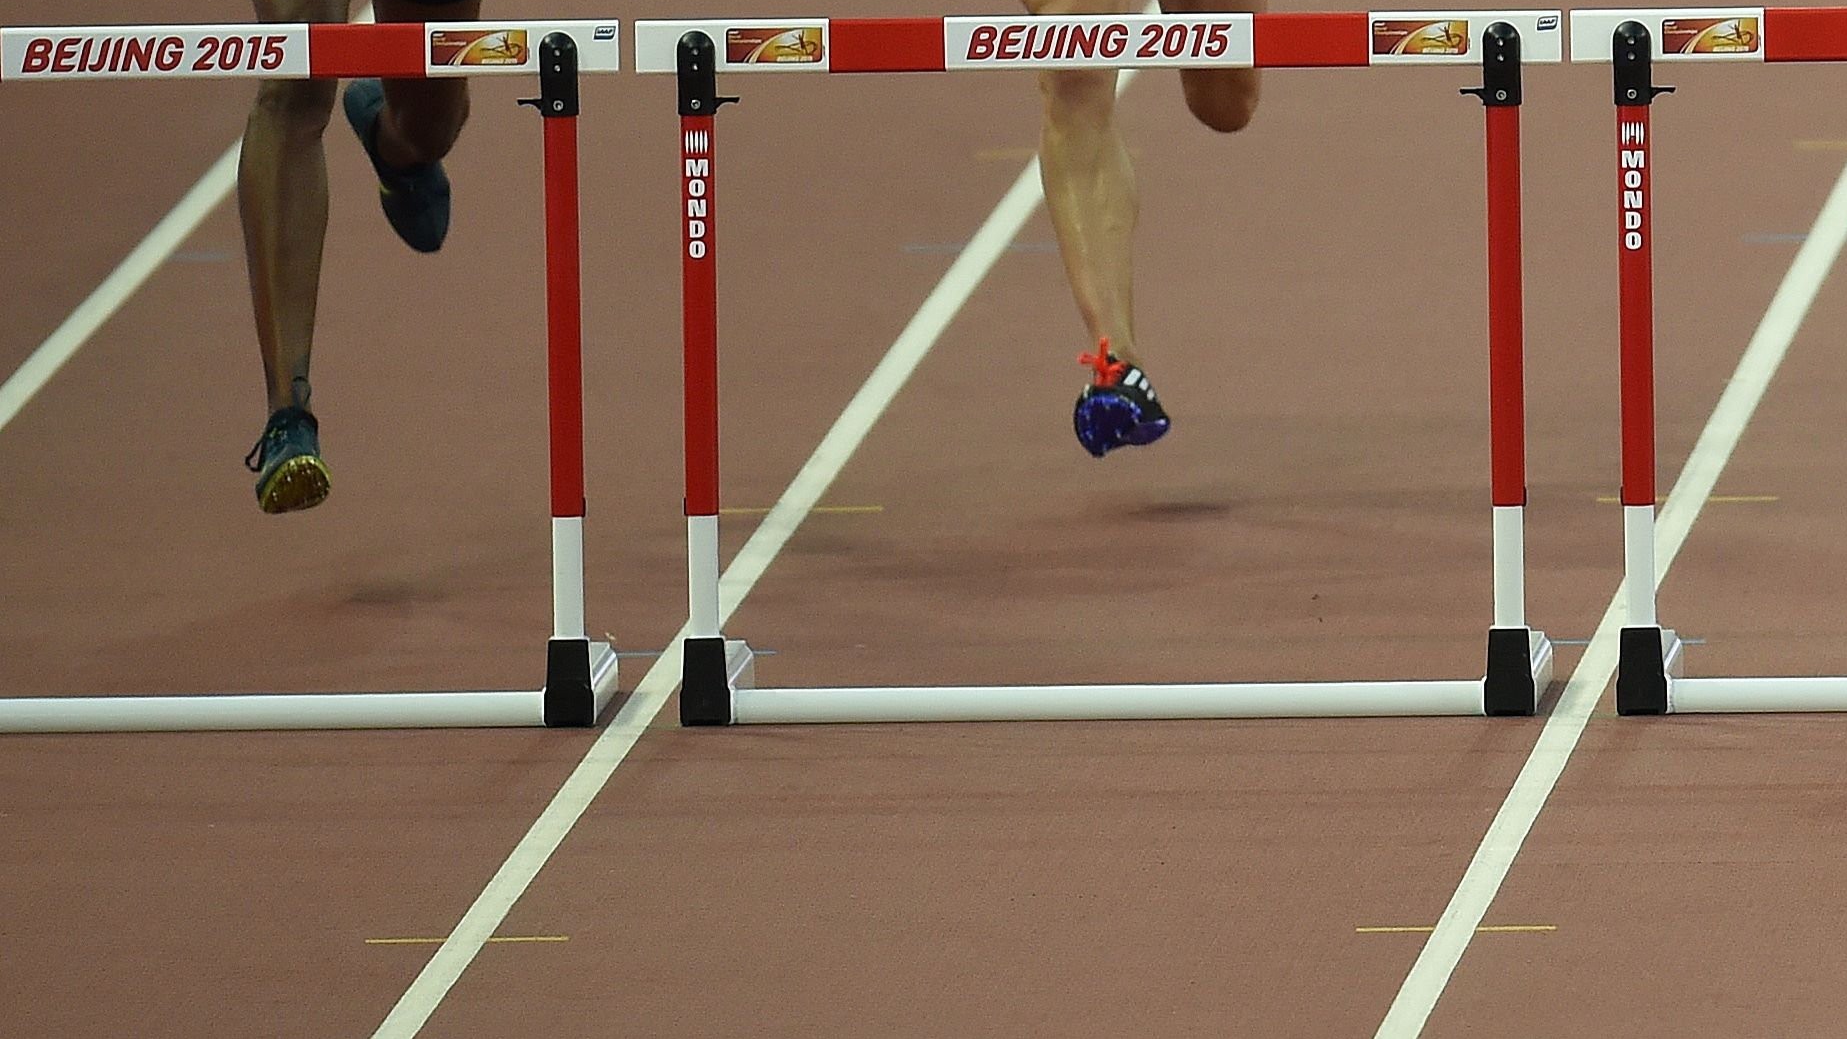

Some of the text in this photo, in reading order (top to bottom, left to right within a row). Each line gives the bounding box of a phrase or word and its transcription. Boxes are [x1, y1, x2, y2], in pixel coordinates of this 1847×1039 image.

[22, 35, 288, 73] BEIJING 2015
[966, 23, 1233, 60] BEIJING 2015
[685, 159, 709, 258] MONDO
[1621, 150, 1645, 250] MONDO
